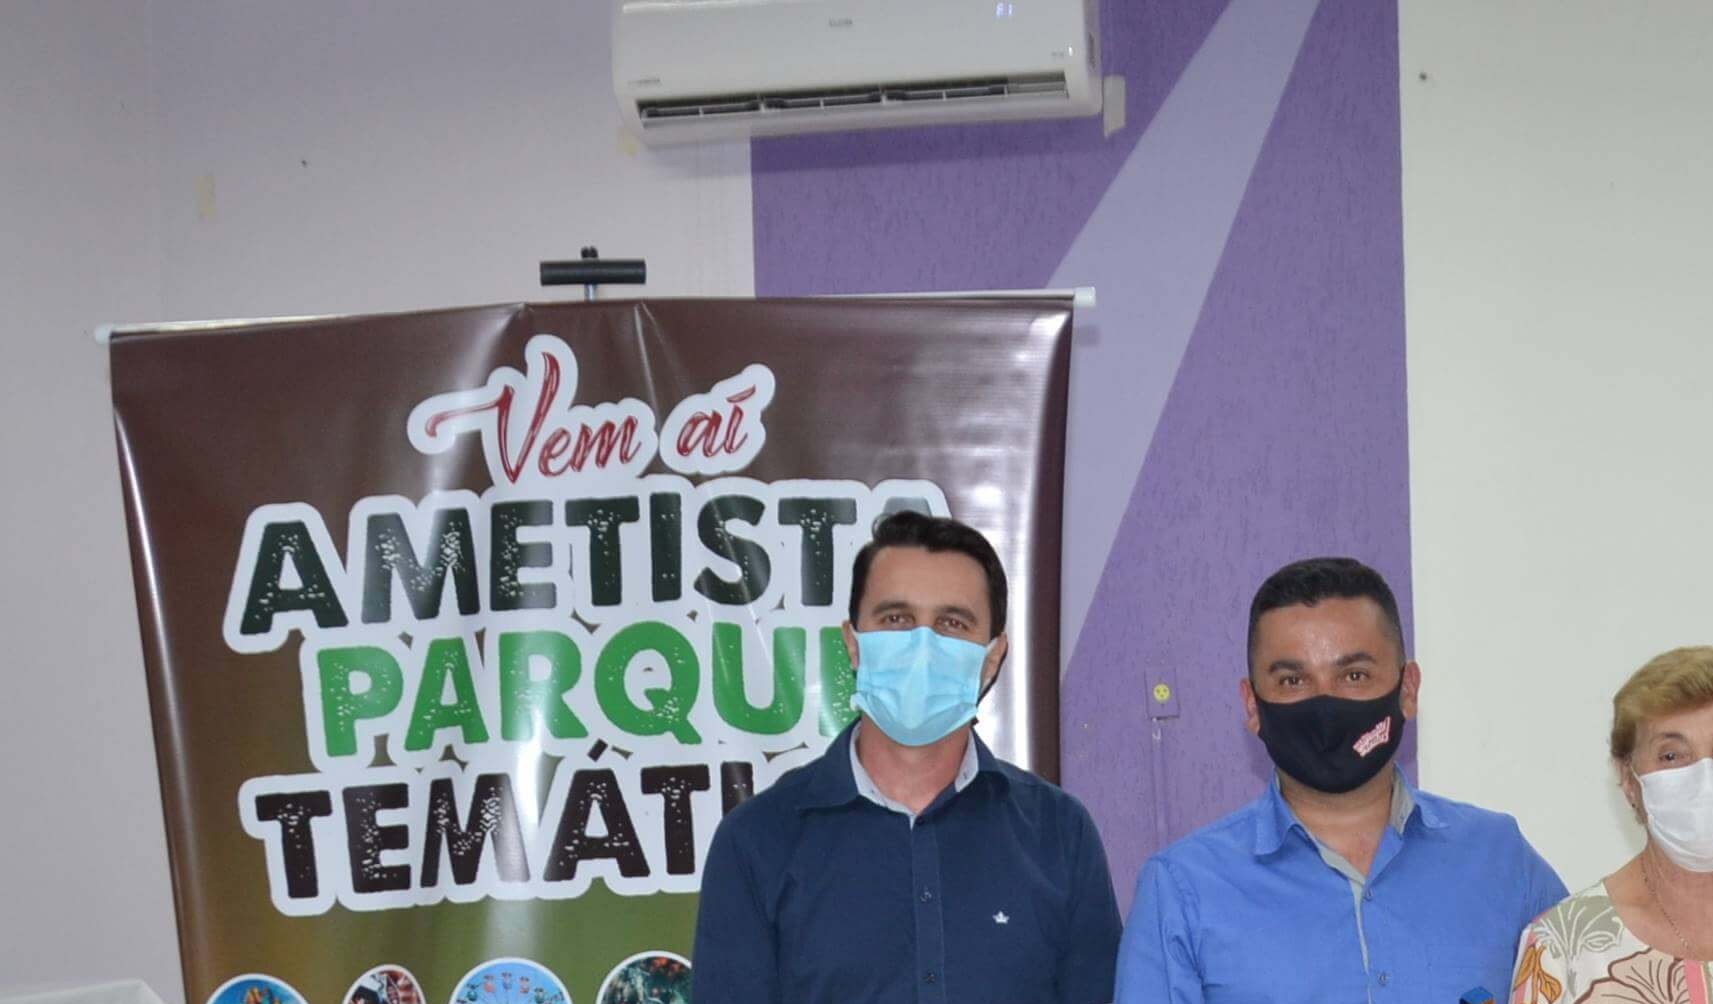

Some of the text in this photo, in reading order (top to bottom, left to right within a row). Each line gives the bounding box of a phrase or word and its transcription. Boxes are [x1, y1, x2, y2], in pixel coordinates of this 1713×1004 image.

[425, 351, 756, 484] Vem aí
[239, 492, 934, 635] AMETIST
